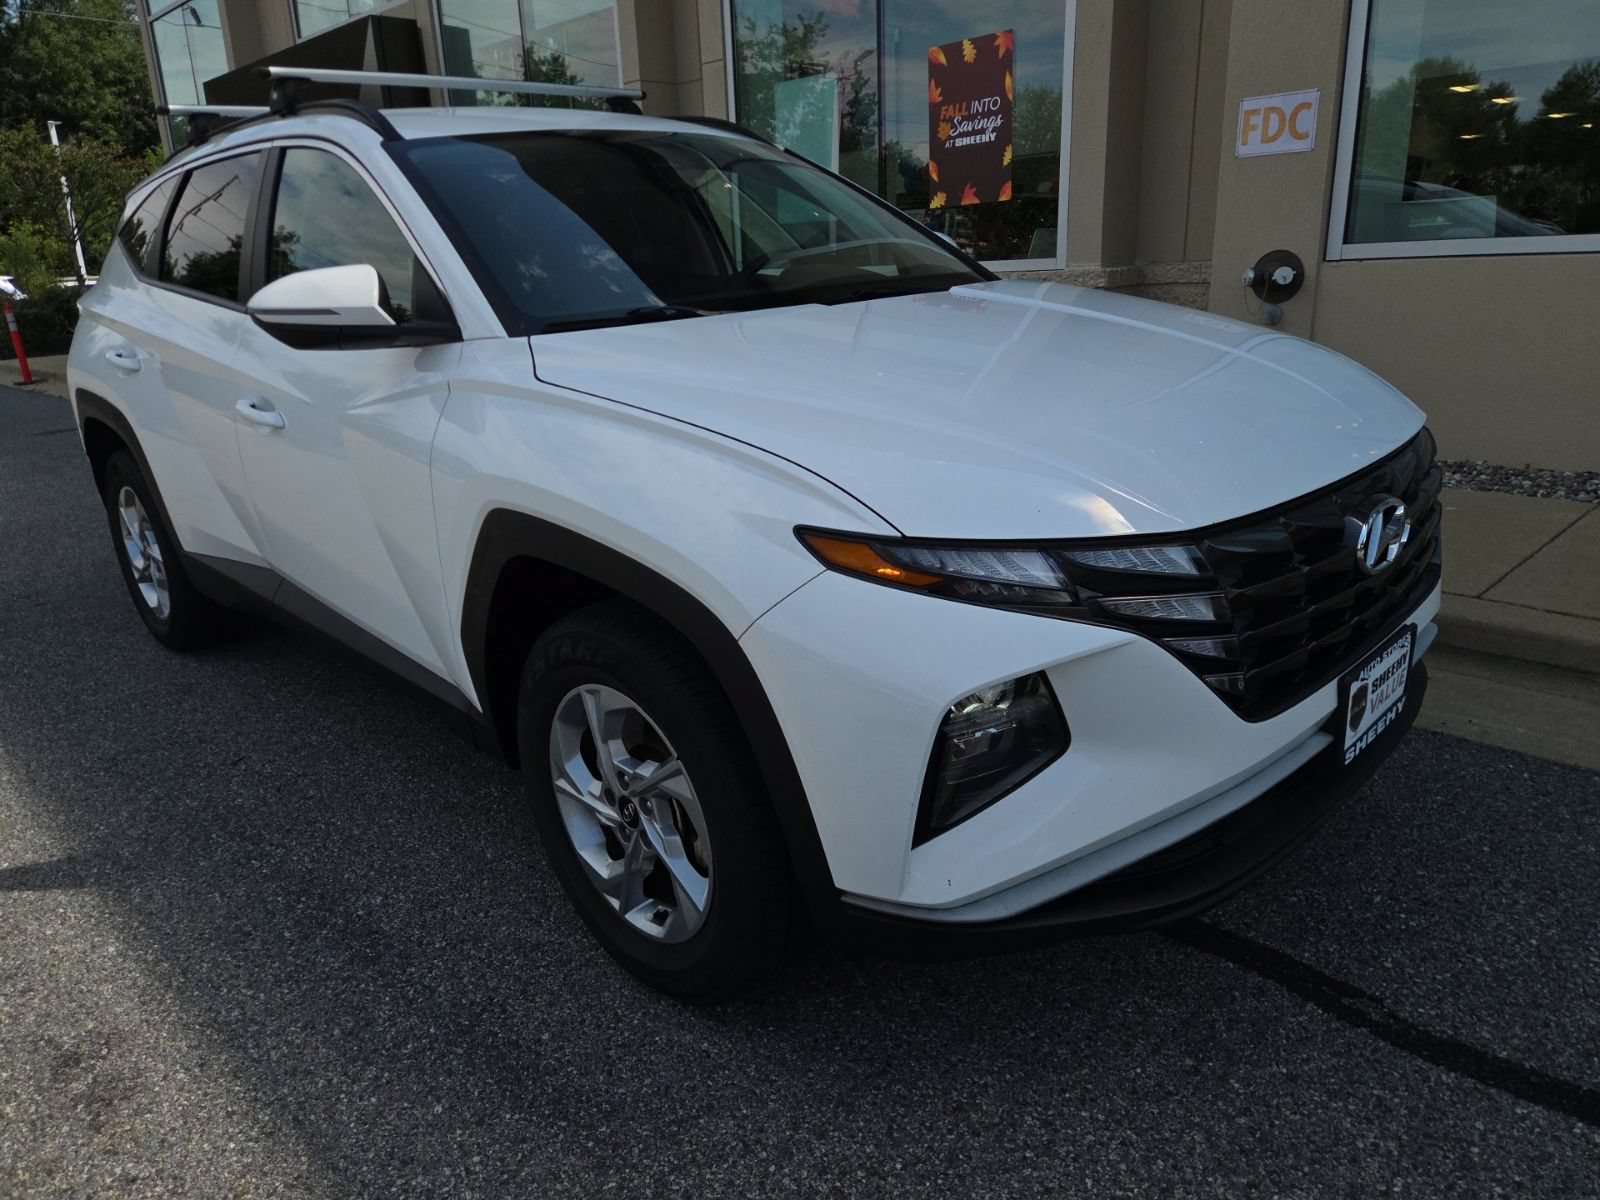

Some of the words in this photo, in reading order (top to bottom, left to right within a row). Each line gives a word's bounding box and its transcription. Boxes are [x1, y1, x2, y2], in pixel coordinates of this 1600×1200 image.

[940, 102, 968, 119] FALL
[970, 96, 1001, 114] INTO
[949, 114, 1004, 137] Savings
[1241, 101, 1313, 146] FDC
[944, 139, 954, 149] AT
[954, 132, 997, 147] SHEEHY
[1370, 666, 1407, 714] VALUE
[1371, 650, 1409, 695] SHEEHY
[1344, 695, 1407, 766] SHEEHY
